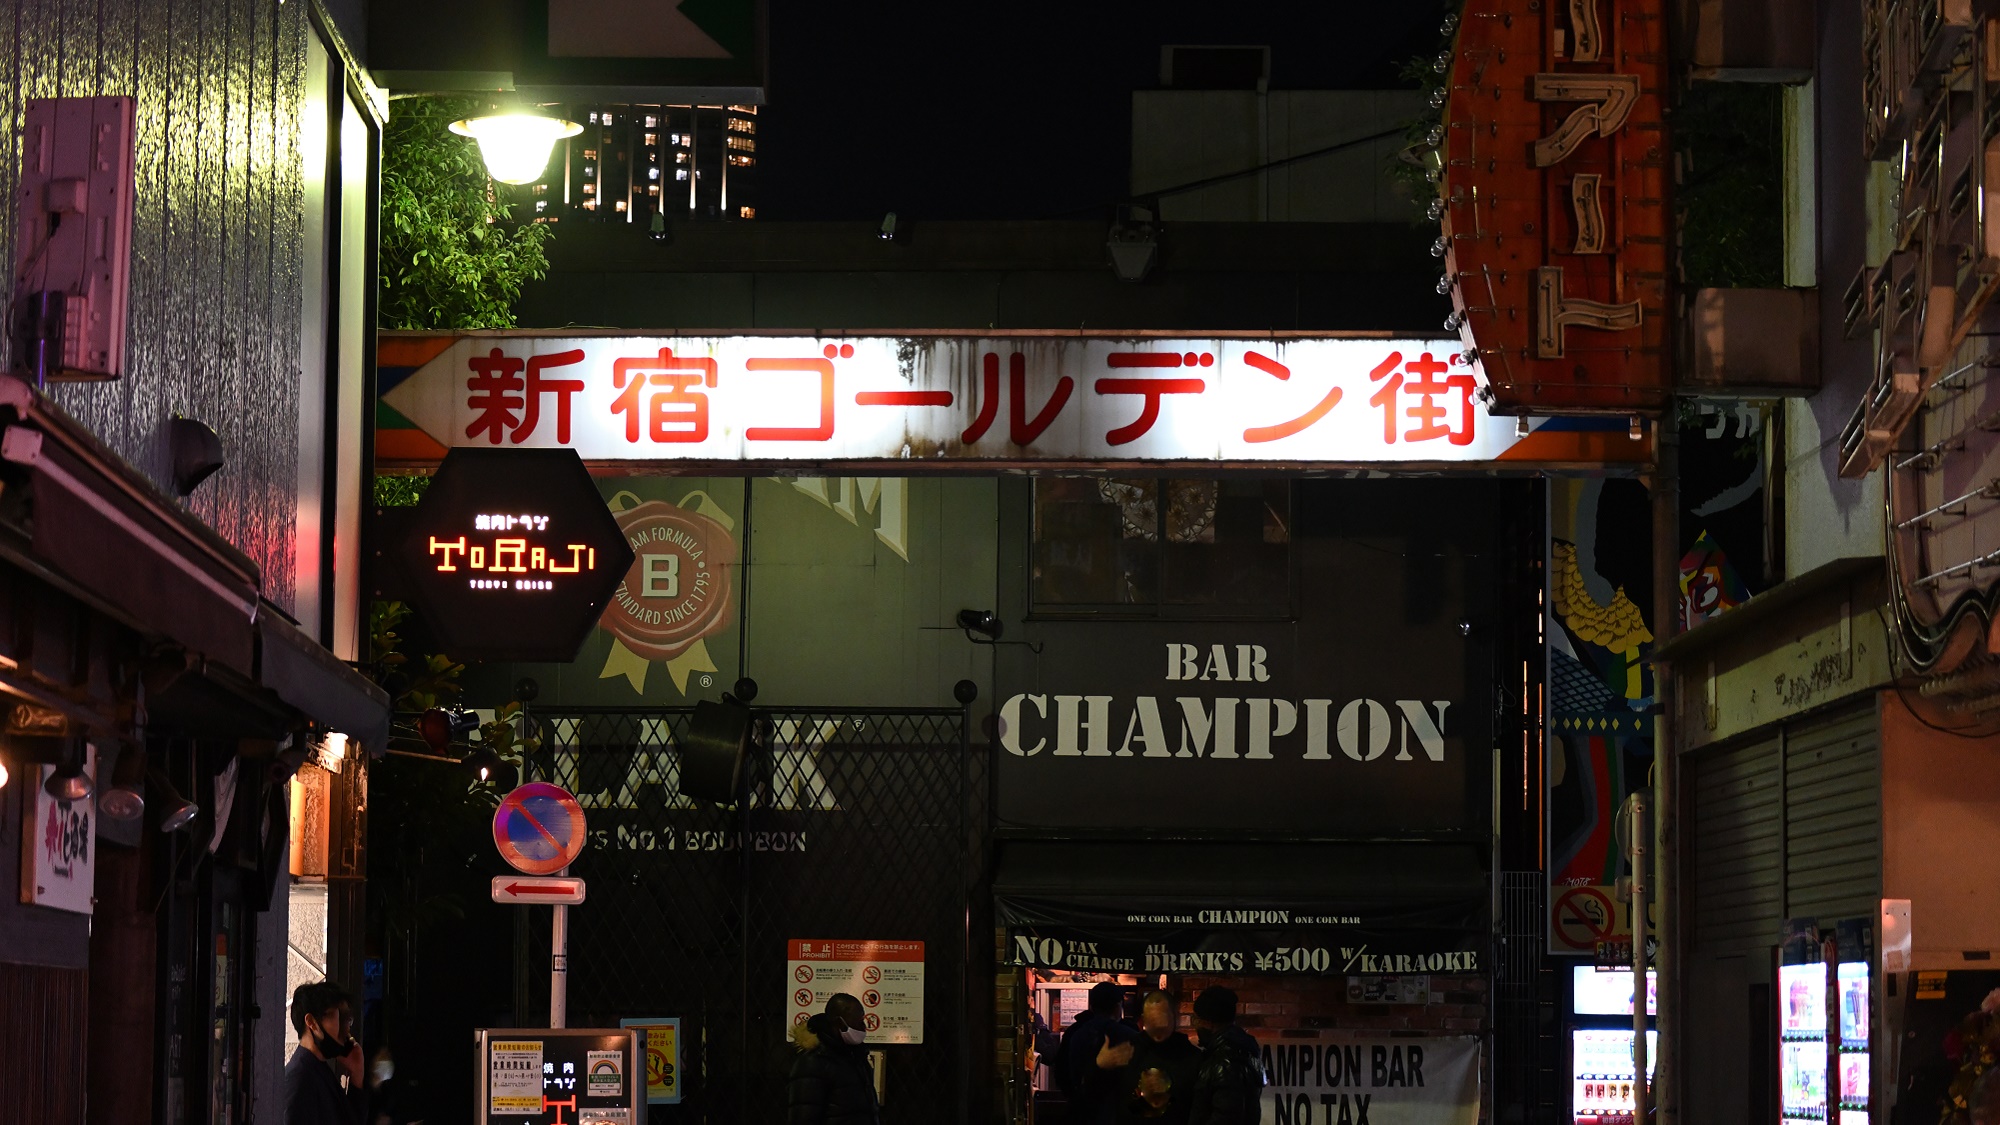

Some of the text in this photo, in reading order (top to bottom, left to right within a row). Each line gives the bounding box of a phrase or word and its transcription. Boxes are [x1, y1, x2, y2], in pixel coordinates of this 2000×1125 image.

[464, 344, 1477, 447] 新宿ゴールデン街
[428, 536, 596, 573] TORAJI
[630, 526, 704, 561] AM FORMULA
[640, 553, 680, 598] B
[664, 599, 697, 625] SINCE
[691, 572, 711, 602] 1795
[1165, 642, 1271, 682] BAR
[998, 692, 1452, 762] CHAMPION
[467, 711, 846, 811] LAK
[1127, 909, 1361, 925] ONE COIN BAR CHAMPION ONE COIN BAR
[1012, 934, 1064, 966] NO
[1065, 954, 1135, 971] CHARGE
[1066, 940, 1099, 955] TAX
[1144, 952, 1244, 972] DRINK'S
[1253, 946, 1331, 972] ¥500
[1145, 943, 1169, 954] ALL
[1261, 1043, 1425, 1088] AMPION BAR
[1274, 1093, 1371, 1125] NO TAX
